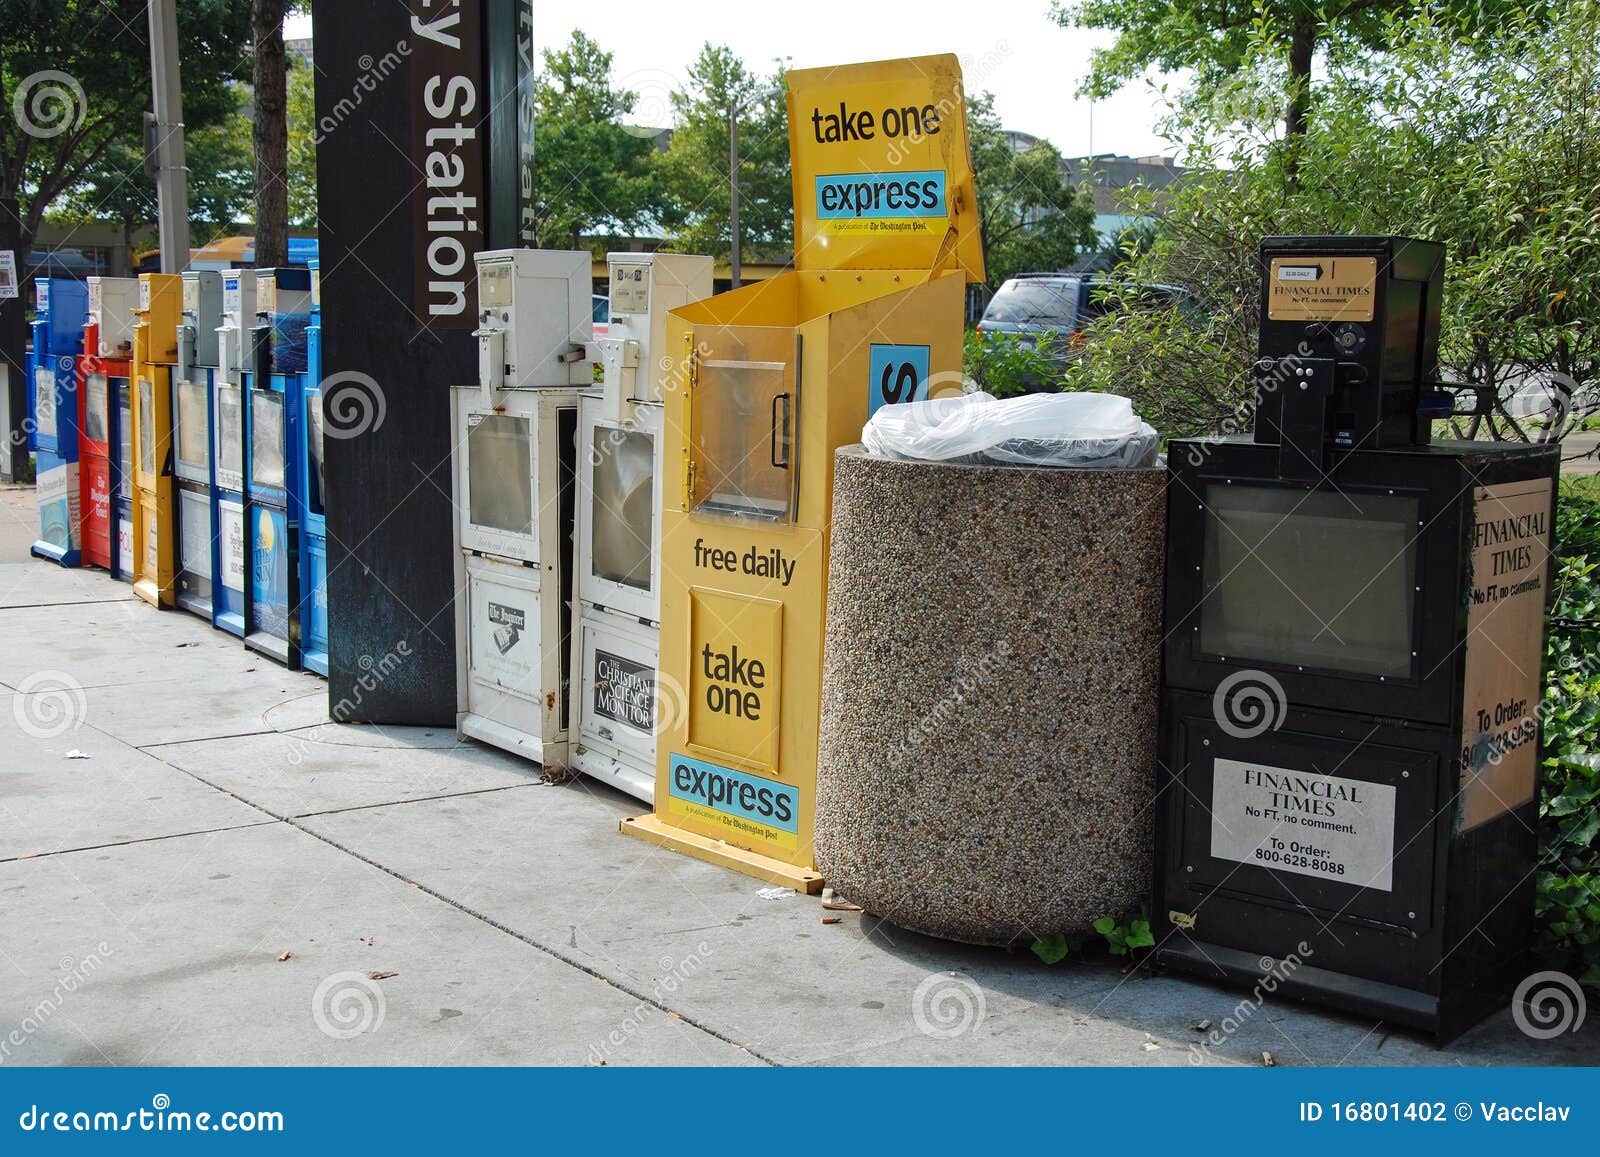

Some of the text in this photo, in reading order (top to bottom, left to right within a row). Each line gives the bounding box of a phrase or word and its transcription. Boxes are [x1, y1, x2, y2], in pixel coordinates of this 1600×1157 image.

[811, 102, 941, 144] take one
[520, 93, 535, 249] Stati
[423, 74, 478, 316] Station
[821, 180, 939, 216] express
[1274, 286, 1370, 296] FINANCIAL TIMES
[1474, 512, 1547, 548] FINANCIAL
[694, 538, 796, 587] free daily
[1491, 545, 1532, 576] TIMES
[1473, 588, 1485, 605] No
[598, 660, 651, 694] CHRISTIAN
[701, 643, 766, 689] take
[598, 688, 651, 727] MONITOR
[608, 679, 650, 710] SCIENCE
[706, 684, 761, 721] one
[1477, 697, 1527, 733] To Order:
[674, 763, 792, 822] express
[1243, 769, 1363, 804] FINANCIAL
[1268, 791, 1336, 817] TIMES
[722, 815, 732, 826] The
[732, 816, 764, 836] Washington
[764, 828, 778, 841] Post
[1245, 805, 1357, 835] No FT, no comment.
[1255, 848, 1345, 875] 800-628-8088
[1270, 837, 1331, 859] To Order:
